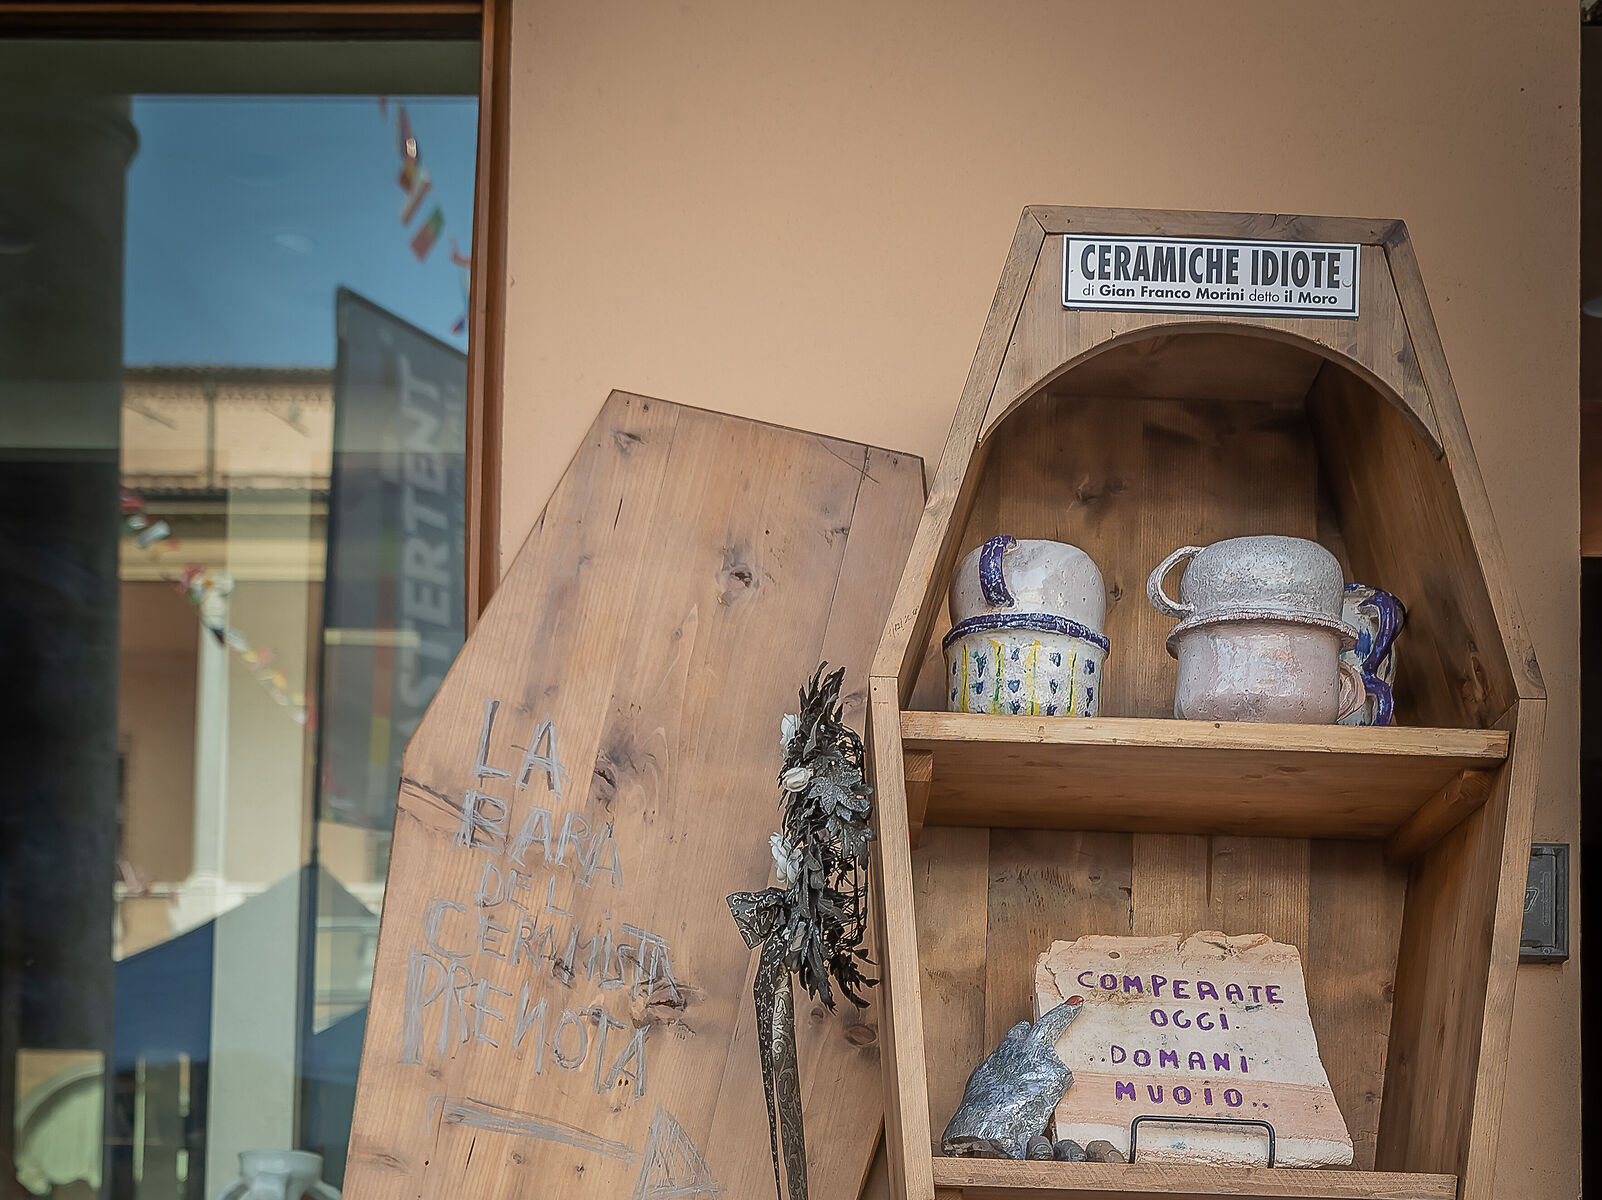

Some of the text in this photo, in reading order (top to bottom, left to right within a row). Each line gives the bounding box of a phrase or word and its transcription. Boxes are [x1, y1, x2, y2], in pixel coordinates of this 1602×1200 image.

[1080, 244, 1341, 289] CERAMICHE IDIOTE
[1082, 283, 1338, 304] di Gian Franco Morini detto il Moro
[473, 698, 569, 798] LA
[1077, 971, 1284, 1004] COMPERATE
